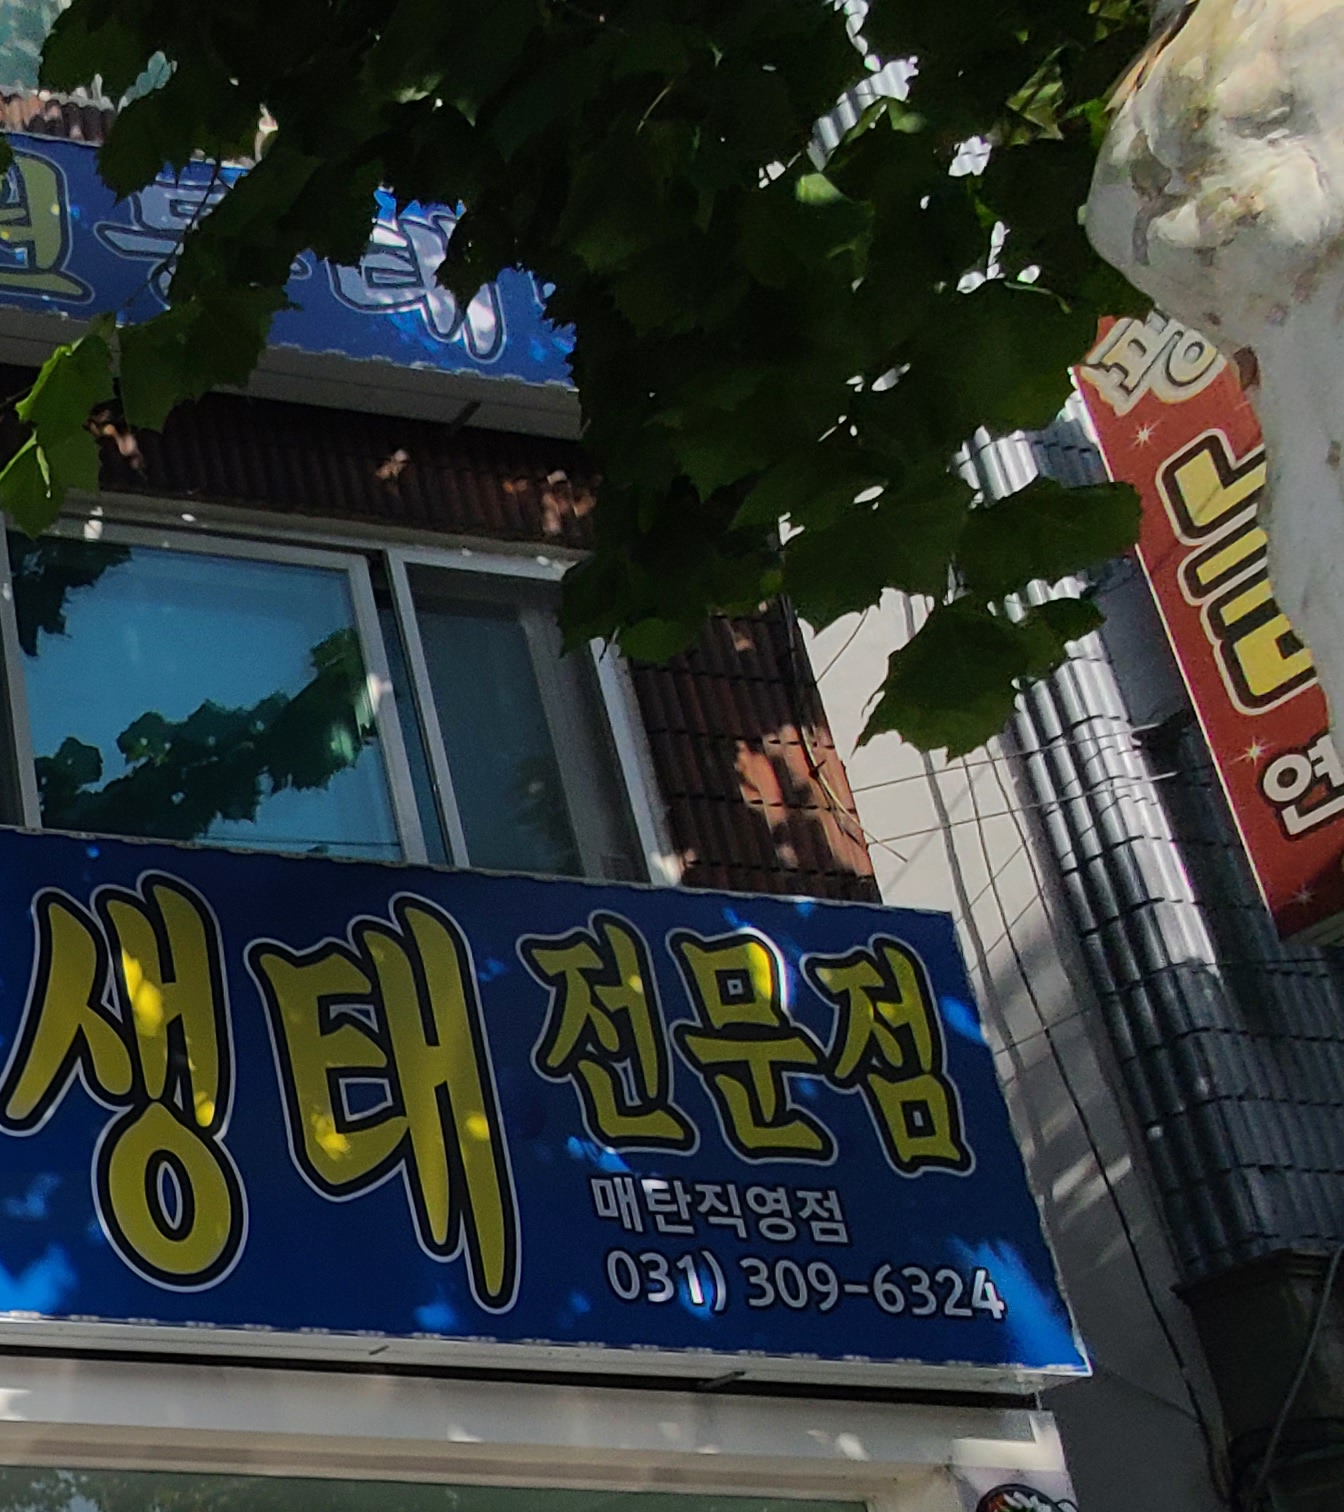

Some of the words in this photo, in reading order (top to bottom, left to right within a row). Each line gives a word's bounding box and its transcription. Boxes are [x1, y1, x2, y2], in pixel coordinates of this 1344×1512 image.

[518, 912, 975, 1176] 전문점
[590, 1176, 850, 1244] 매탄직영점
[606, 1249, 728, 1312] 031)
[739, 1257, 1007, 1320] 309-6324
